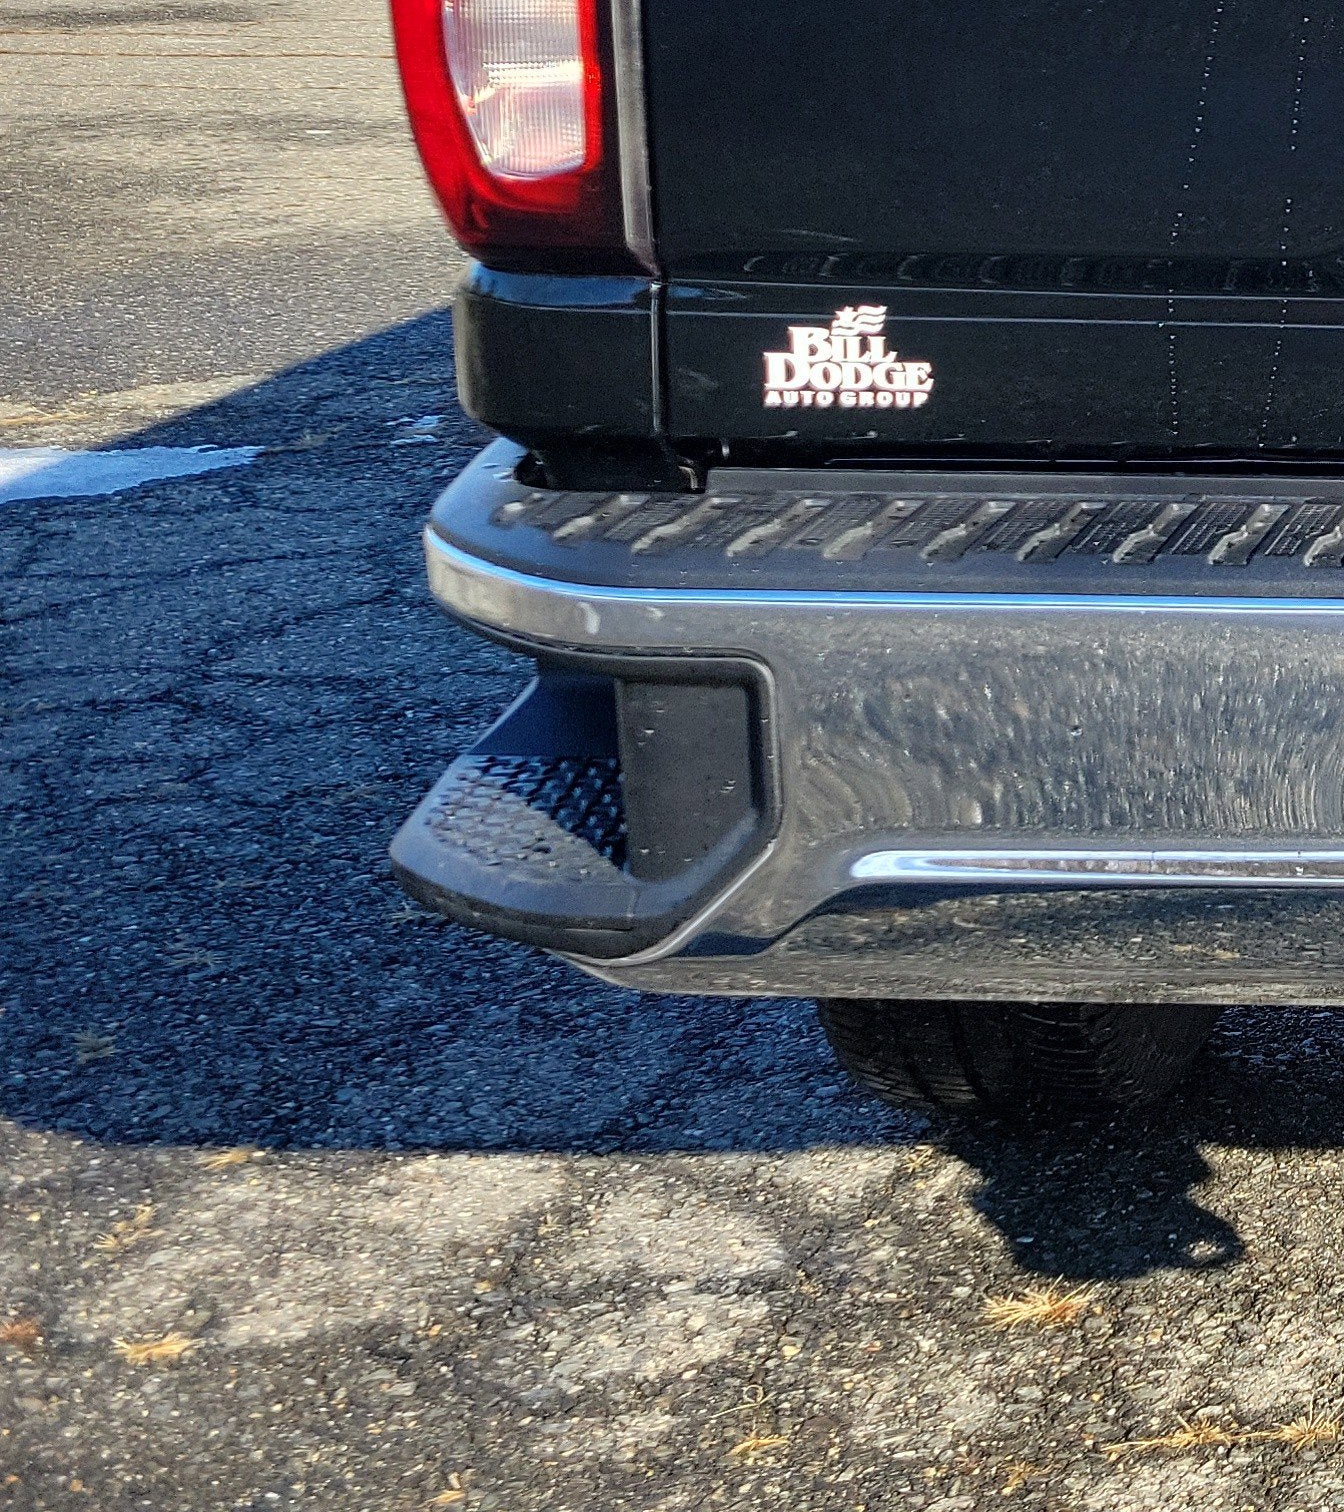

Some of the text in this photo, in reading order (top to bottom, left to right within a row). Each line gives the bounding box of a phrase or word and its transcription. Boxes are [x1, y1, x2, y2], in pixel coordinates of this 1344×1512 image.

[787, 325, 898, 364] BILL
[762, 351, 935, 392] DODGE
[763, 390, 929, 408] AUTO GROUP
